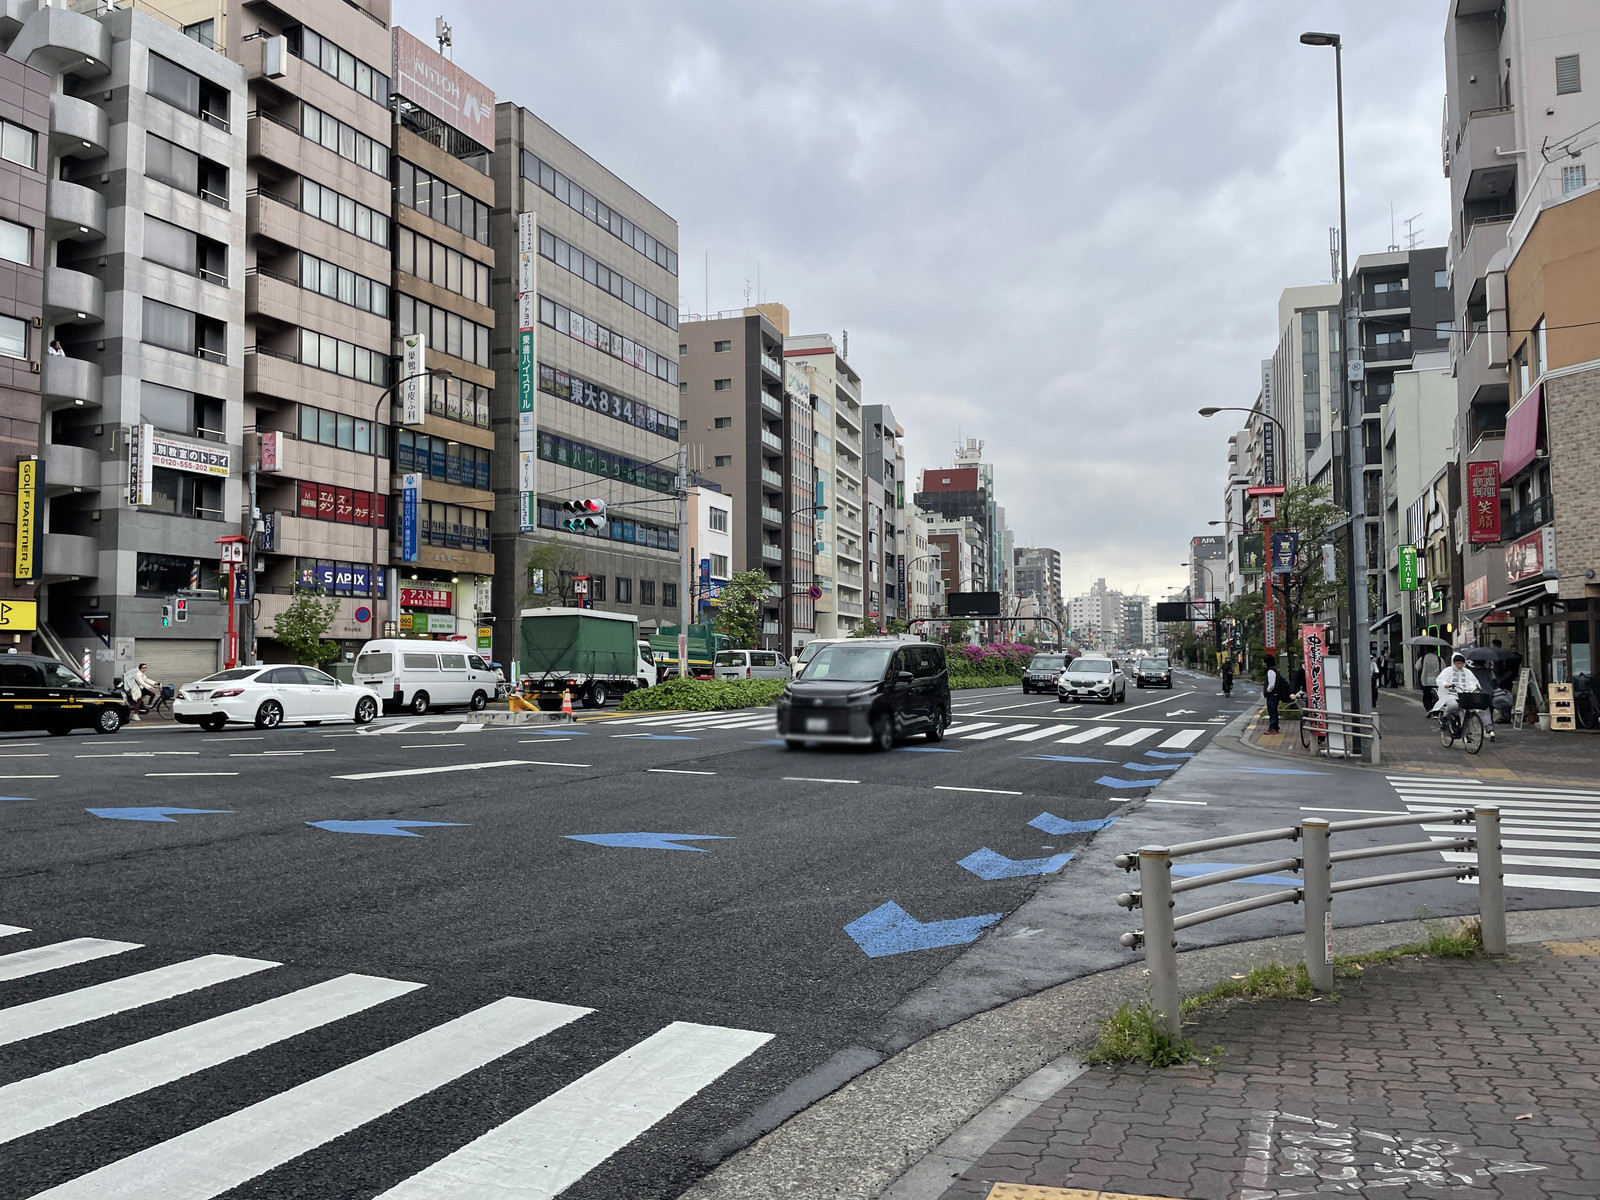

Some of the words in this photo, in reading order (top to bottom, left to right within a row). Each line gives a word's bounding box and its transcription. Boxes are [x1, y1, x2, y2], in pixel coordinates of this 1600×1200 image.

[414, 61, 459, 98] NITTOH
[522, 335, 531, 409] 東進ハイスクール
[160, 457, 208, 472] 0120-555-202
[543, 443, 636, 480] 東進ハイスクール
[23, 464, 31, 498] GOLF
[21, 501, 30, 562] PARTNER
[1477, 500, 1493, 529] 笑顔
[324, 571, 365, 586] SAPIX
[1404, 554, 1412, 589] モスバーガー
